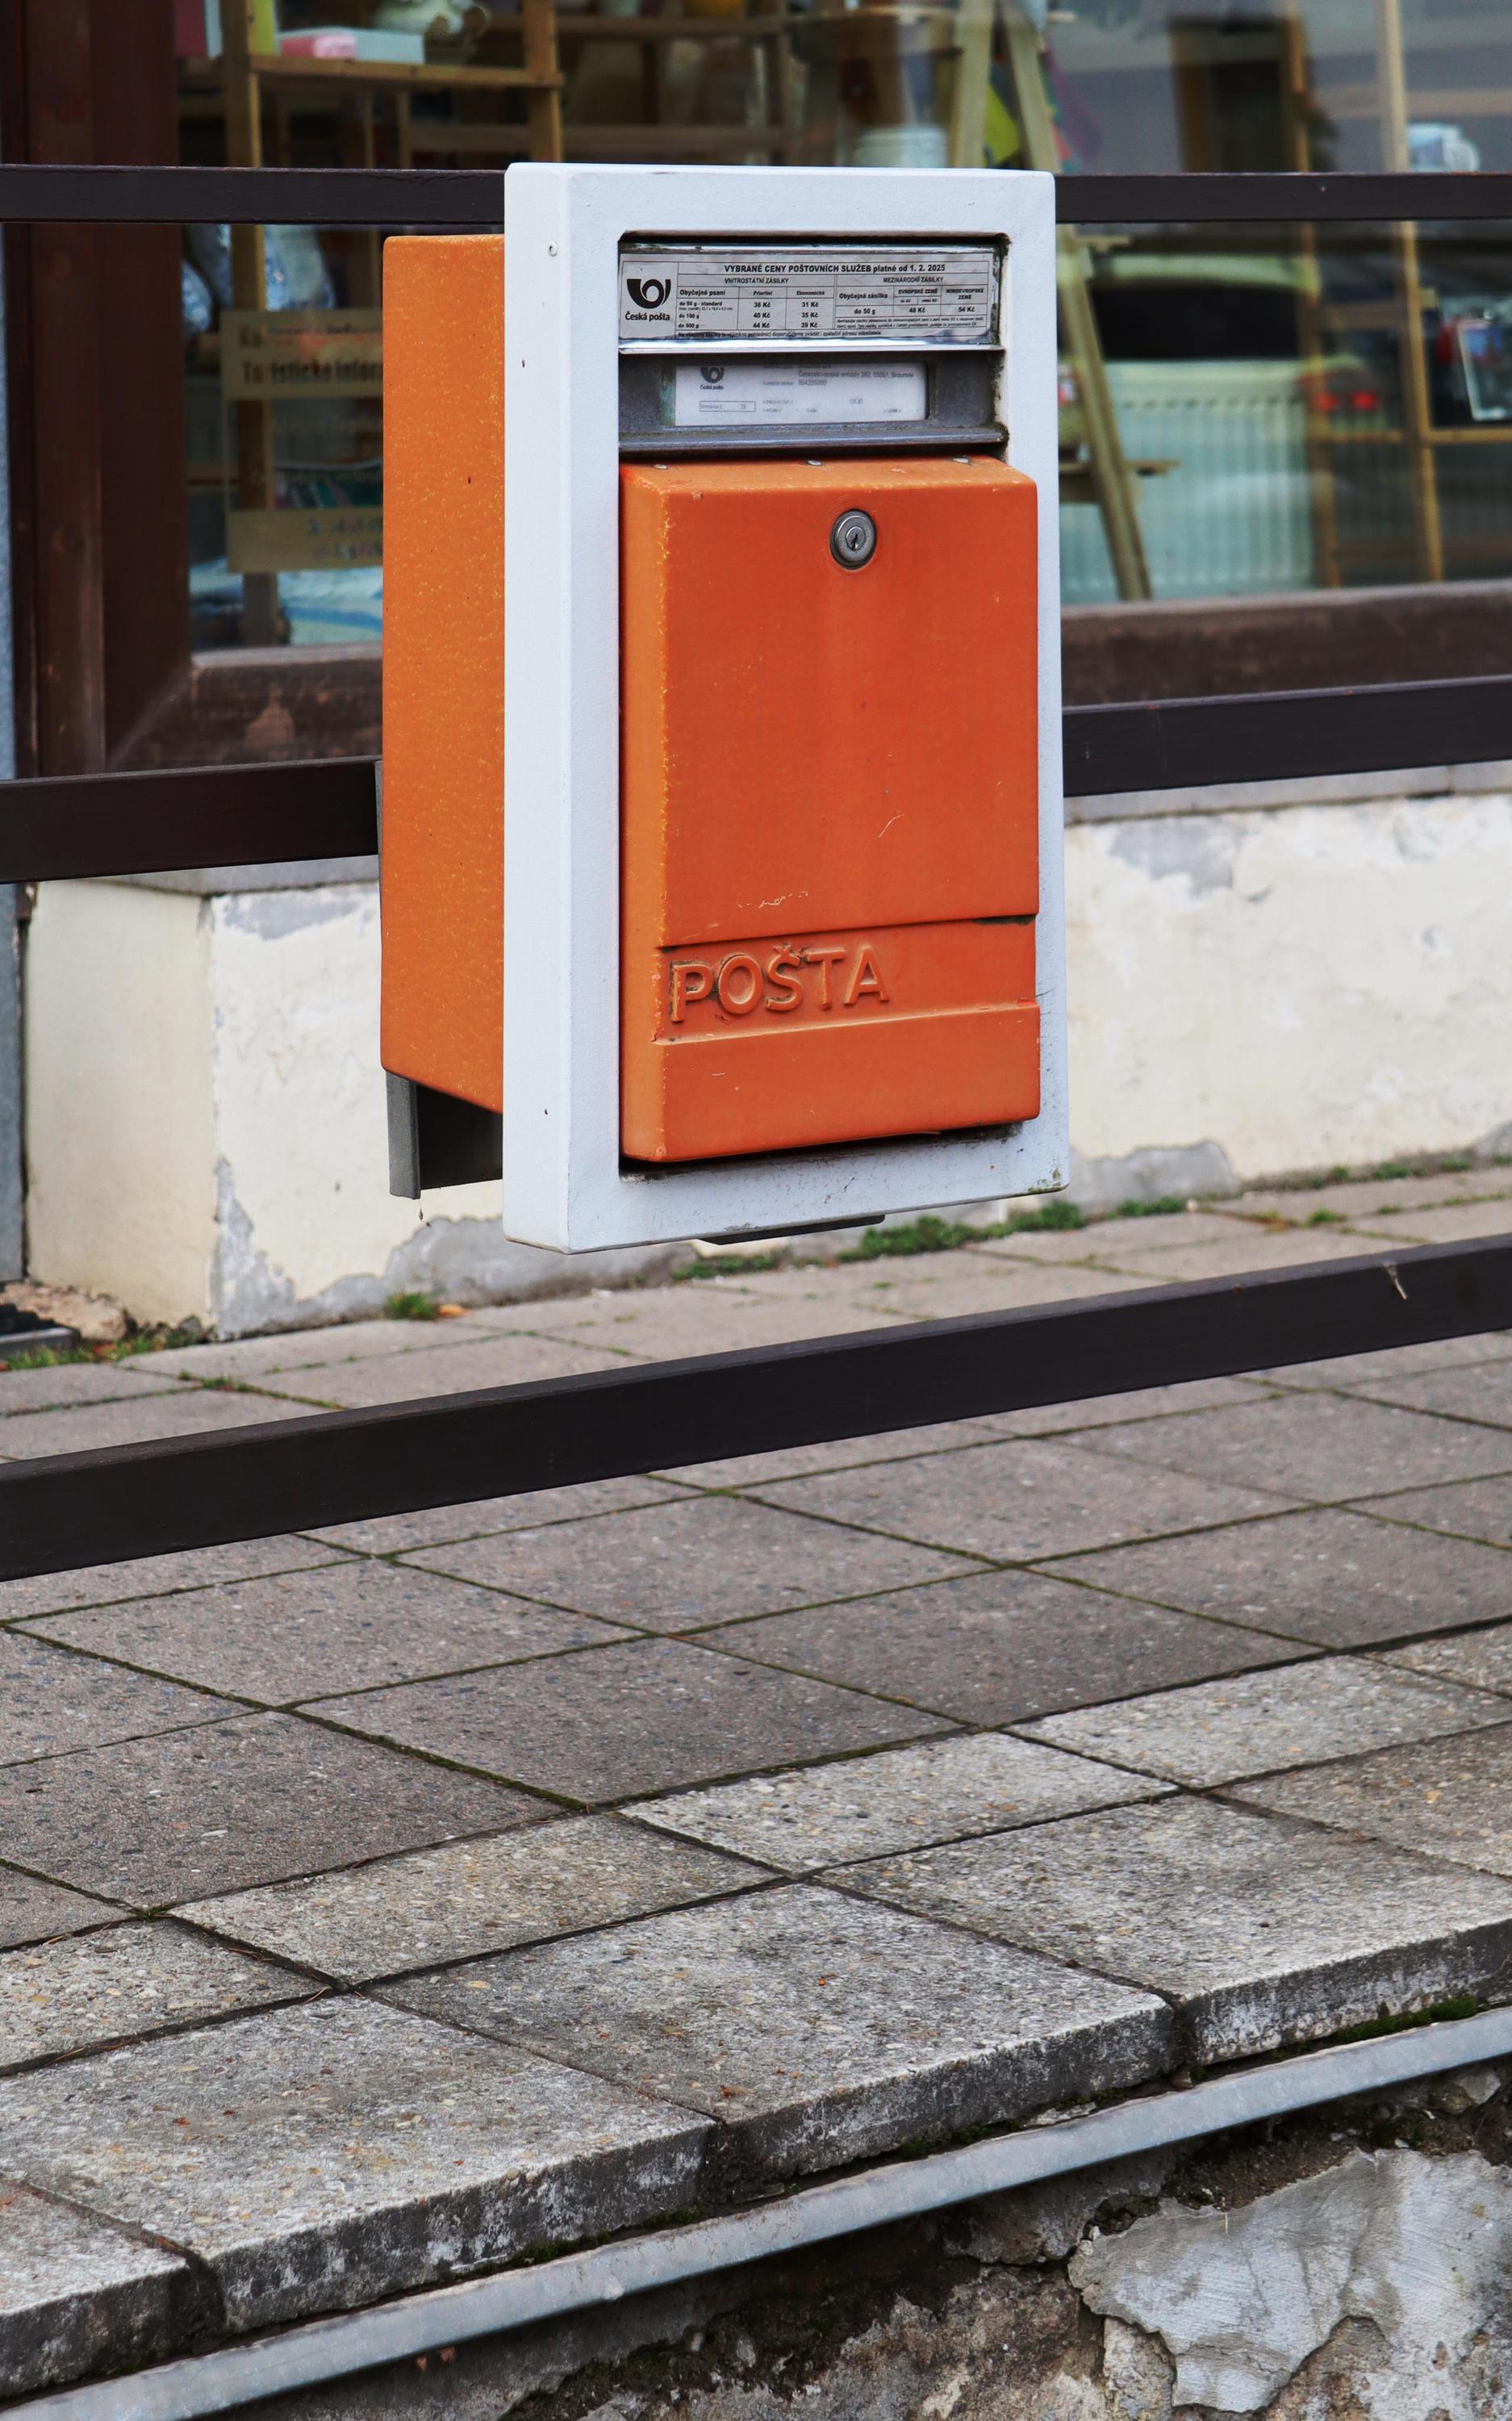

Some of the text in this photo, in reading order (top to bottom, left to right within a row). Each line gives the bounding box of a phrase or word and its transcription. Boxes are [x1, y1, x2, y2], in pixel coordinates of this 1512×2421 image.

[725, 264, 762, 273] VYBRANÉ
[765, 265, 786, 273] CENY
[788, 263, 838, 273] POŠTOVNÍCH
[842, 263, 871, 272] SLUŽEB
[873, 265, 896, 274] platné
[679, 289, 708, 297] Obyčejné
[625, 311, 670, 322] Česká pošta
[670, 943, 889, 1022] POŠTA
